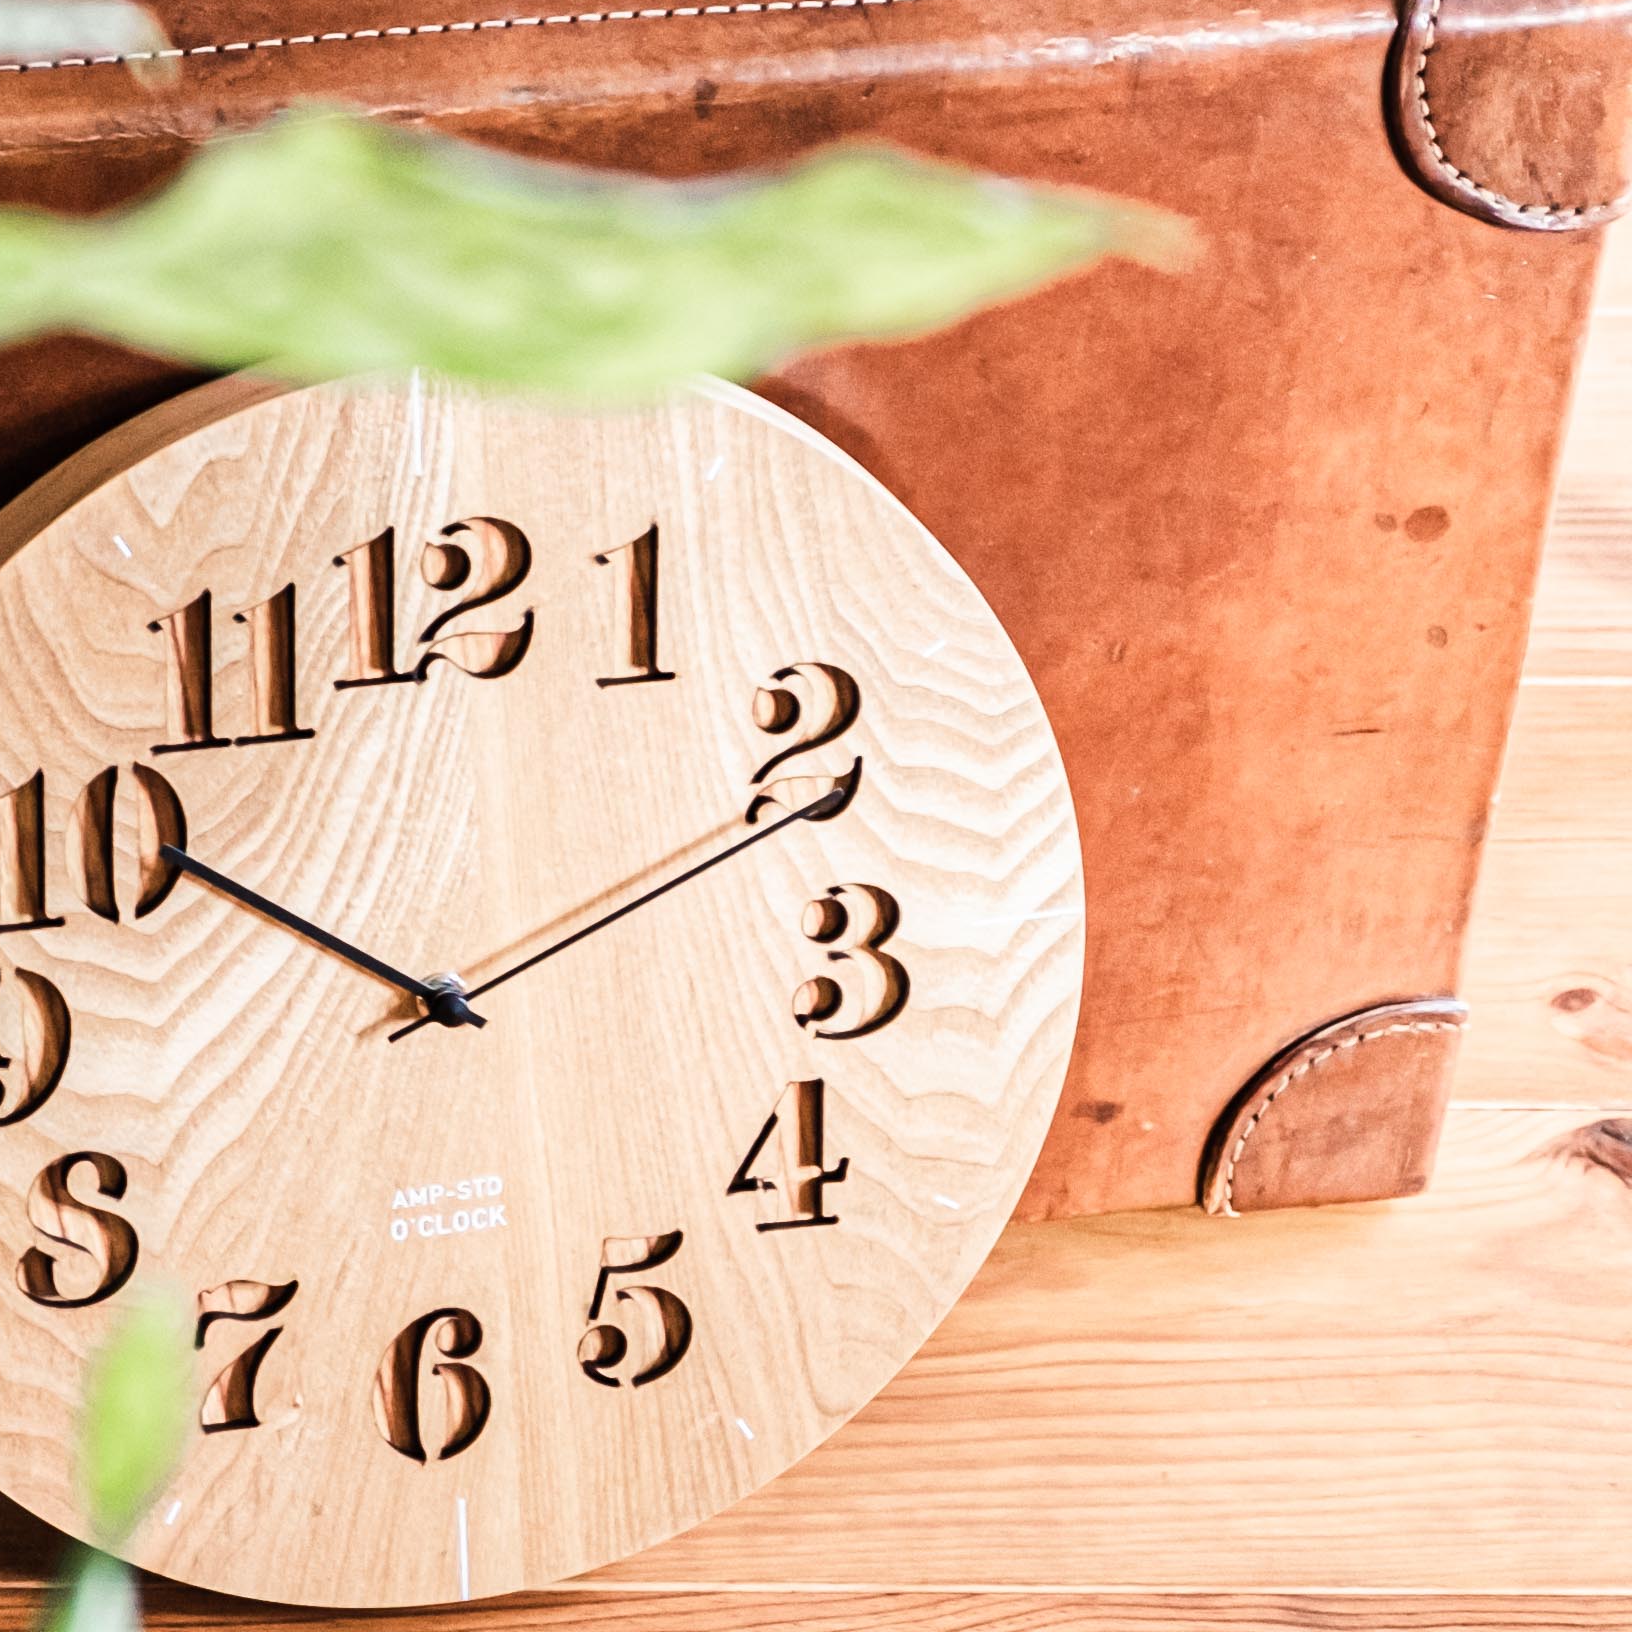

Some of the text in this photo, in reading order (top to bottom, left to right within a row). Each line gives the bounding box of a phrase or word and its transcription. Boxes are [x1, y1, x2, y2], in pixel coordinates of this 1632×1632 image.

[147, 582, 316, 755] 11
[333, 515, 535, 690] 12
[593, 523, 676, 689] 1
[744, 662, 863, 825] 2
[791, 882, 910, 1040] 3
[15, 1150, 139, 1309] 8
[390, 1205, 508, 1243] O'CLOCK
[392, 1175, 503, 1210] AMP-STD
[727, 1077, 850, 1232] 4
[195, 1279, 300, 1435] 7
[374, 1307, 491, 1466] 6
[576, 1229, 694, 1389] 5
